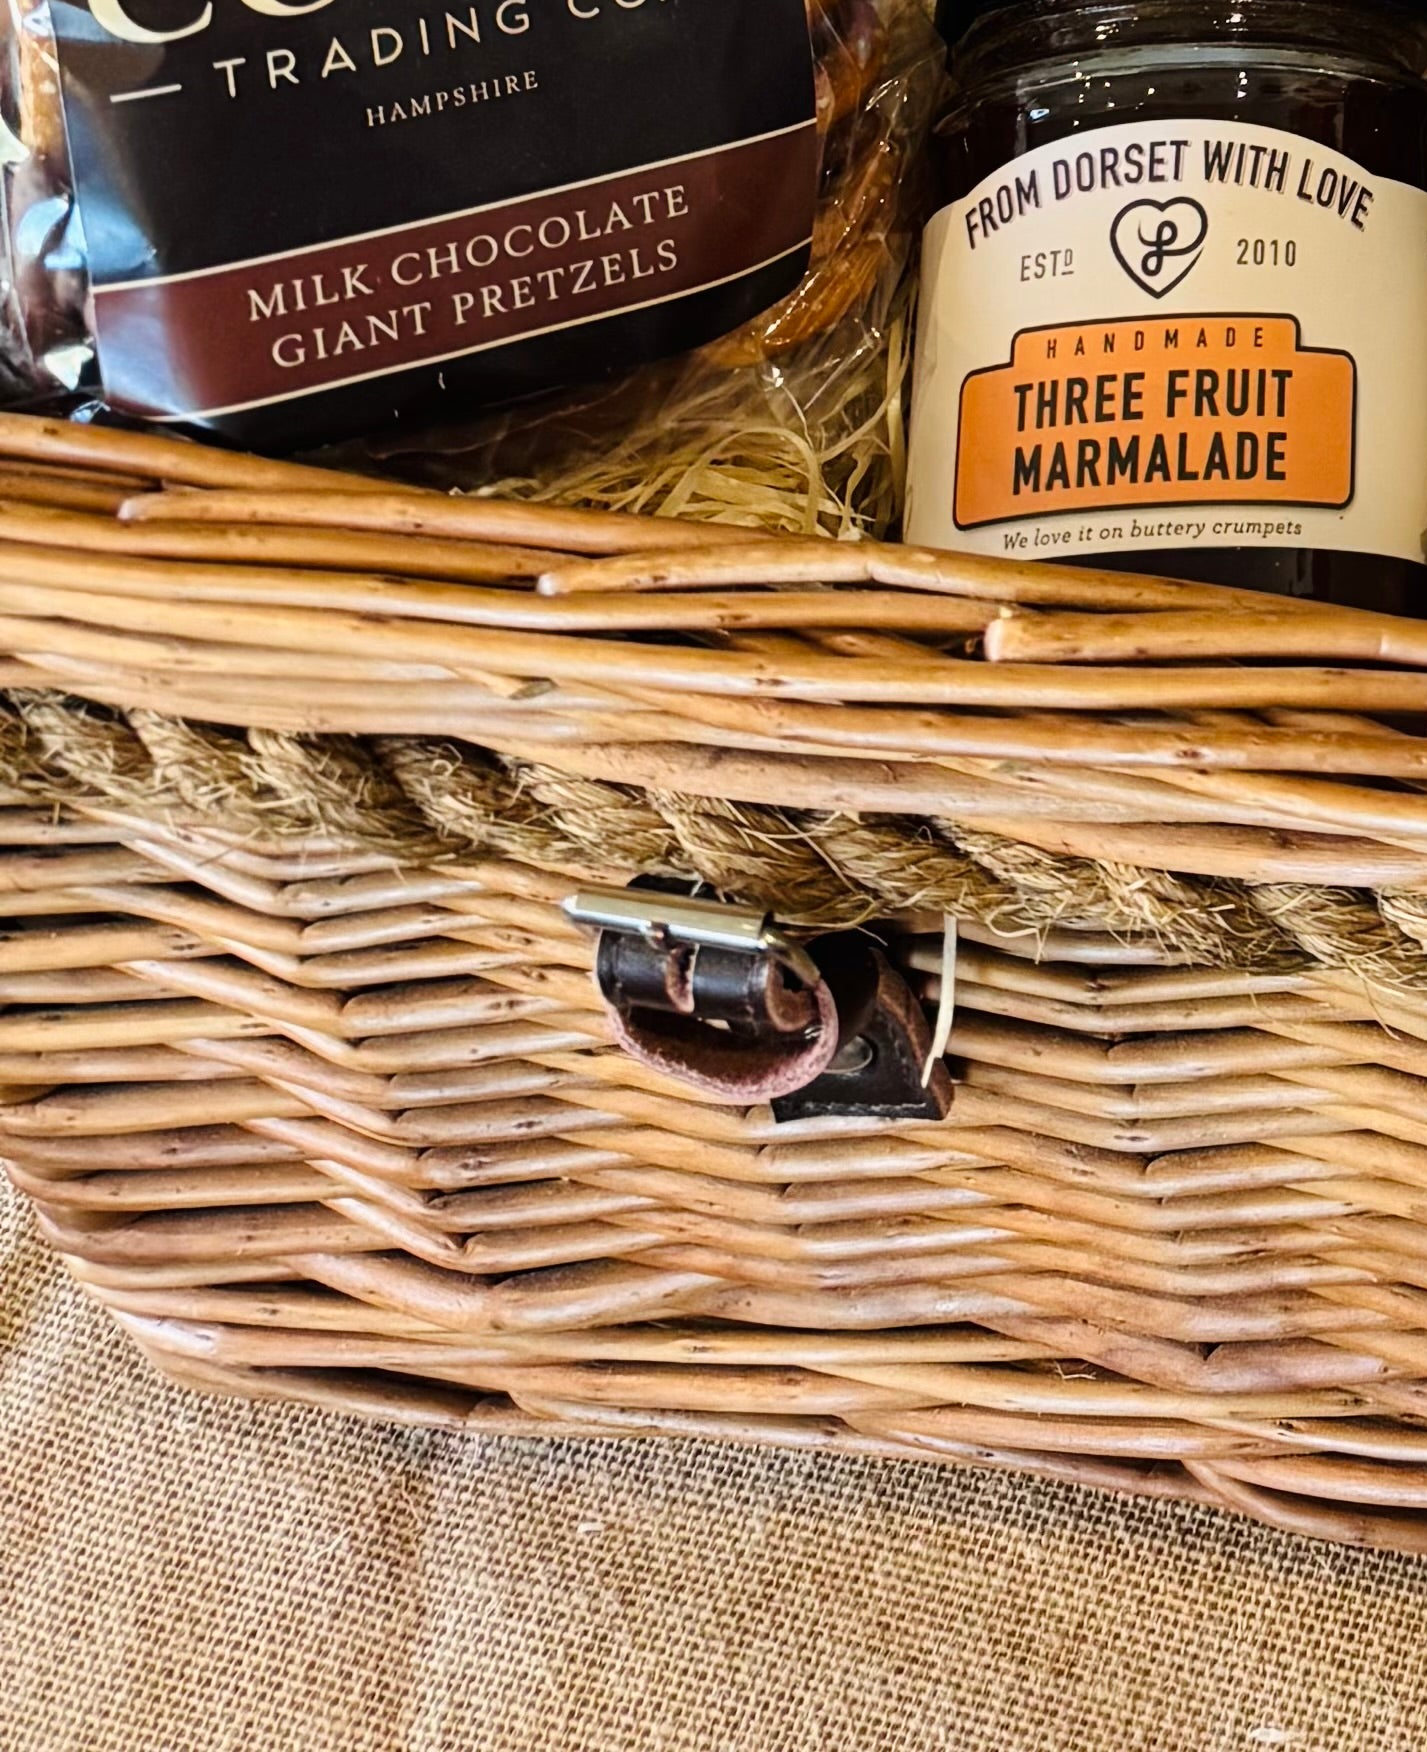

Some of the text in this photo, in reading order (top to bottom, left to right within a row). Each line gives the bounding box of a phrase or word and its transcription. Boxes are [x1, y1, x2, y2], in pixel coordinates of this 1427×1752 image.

[366, 68, 540, 127] HAMPSHIRE
[1236, 239, 1297, 268] 2010
[270, 240, 681, 369] GIANT PRETZELS
[1013, 369, 1293, 433] THREE FRUIT
[1011, 432, 1288, 496] MARMALADE
[1131, 519, 1303, 539] buttery crumpets
